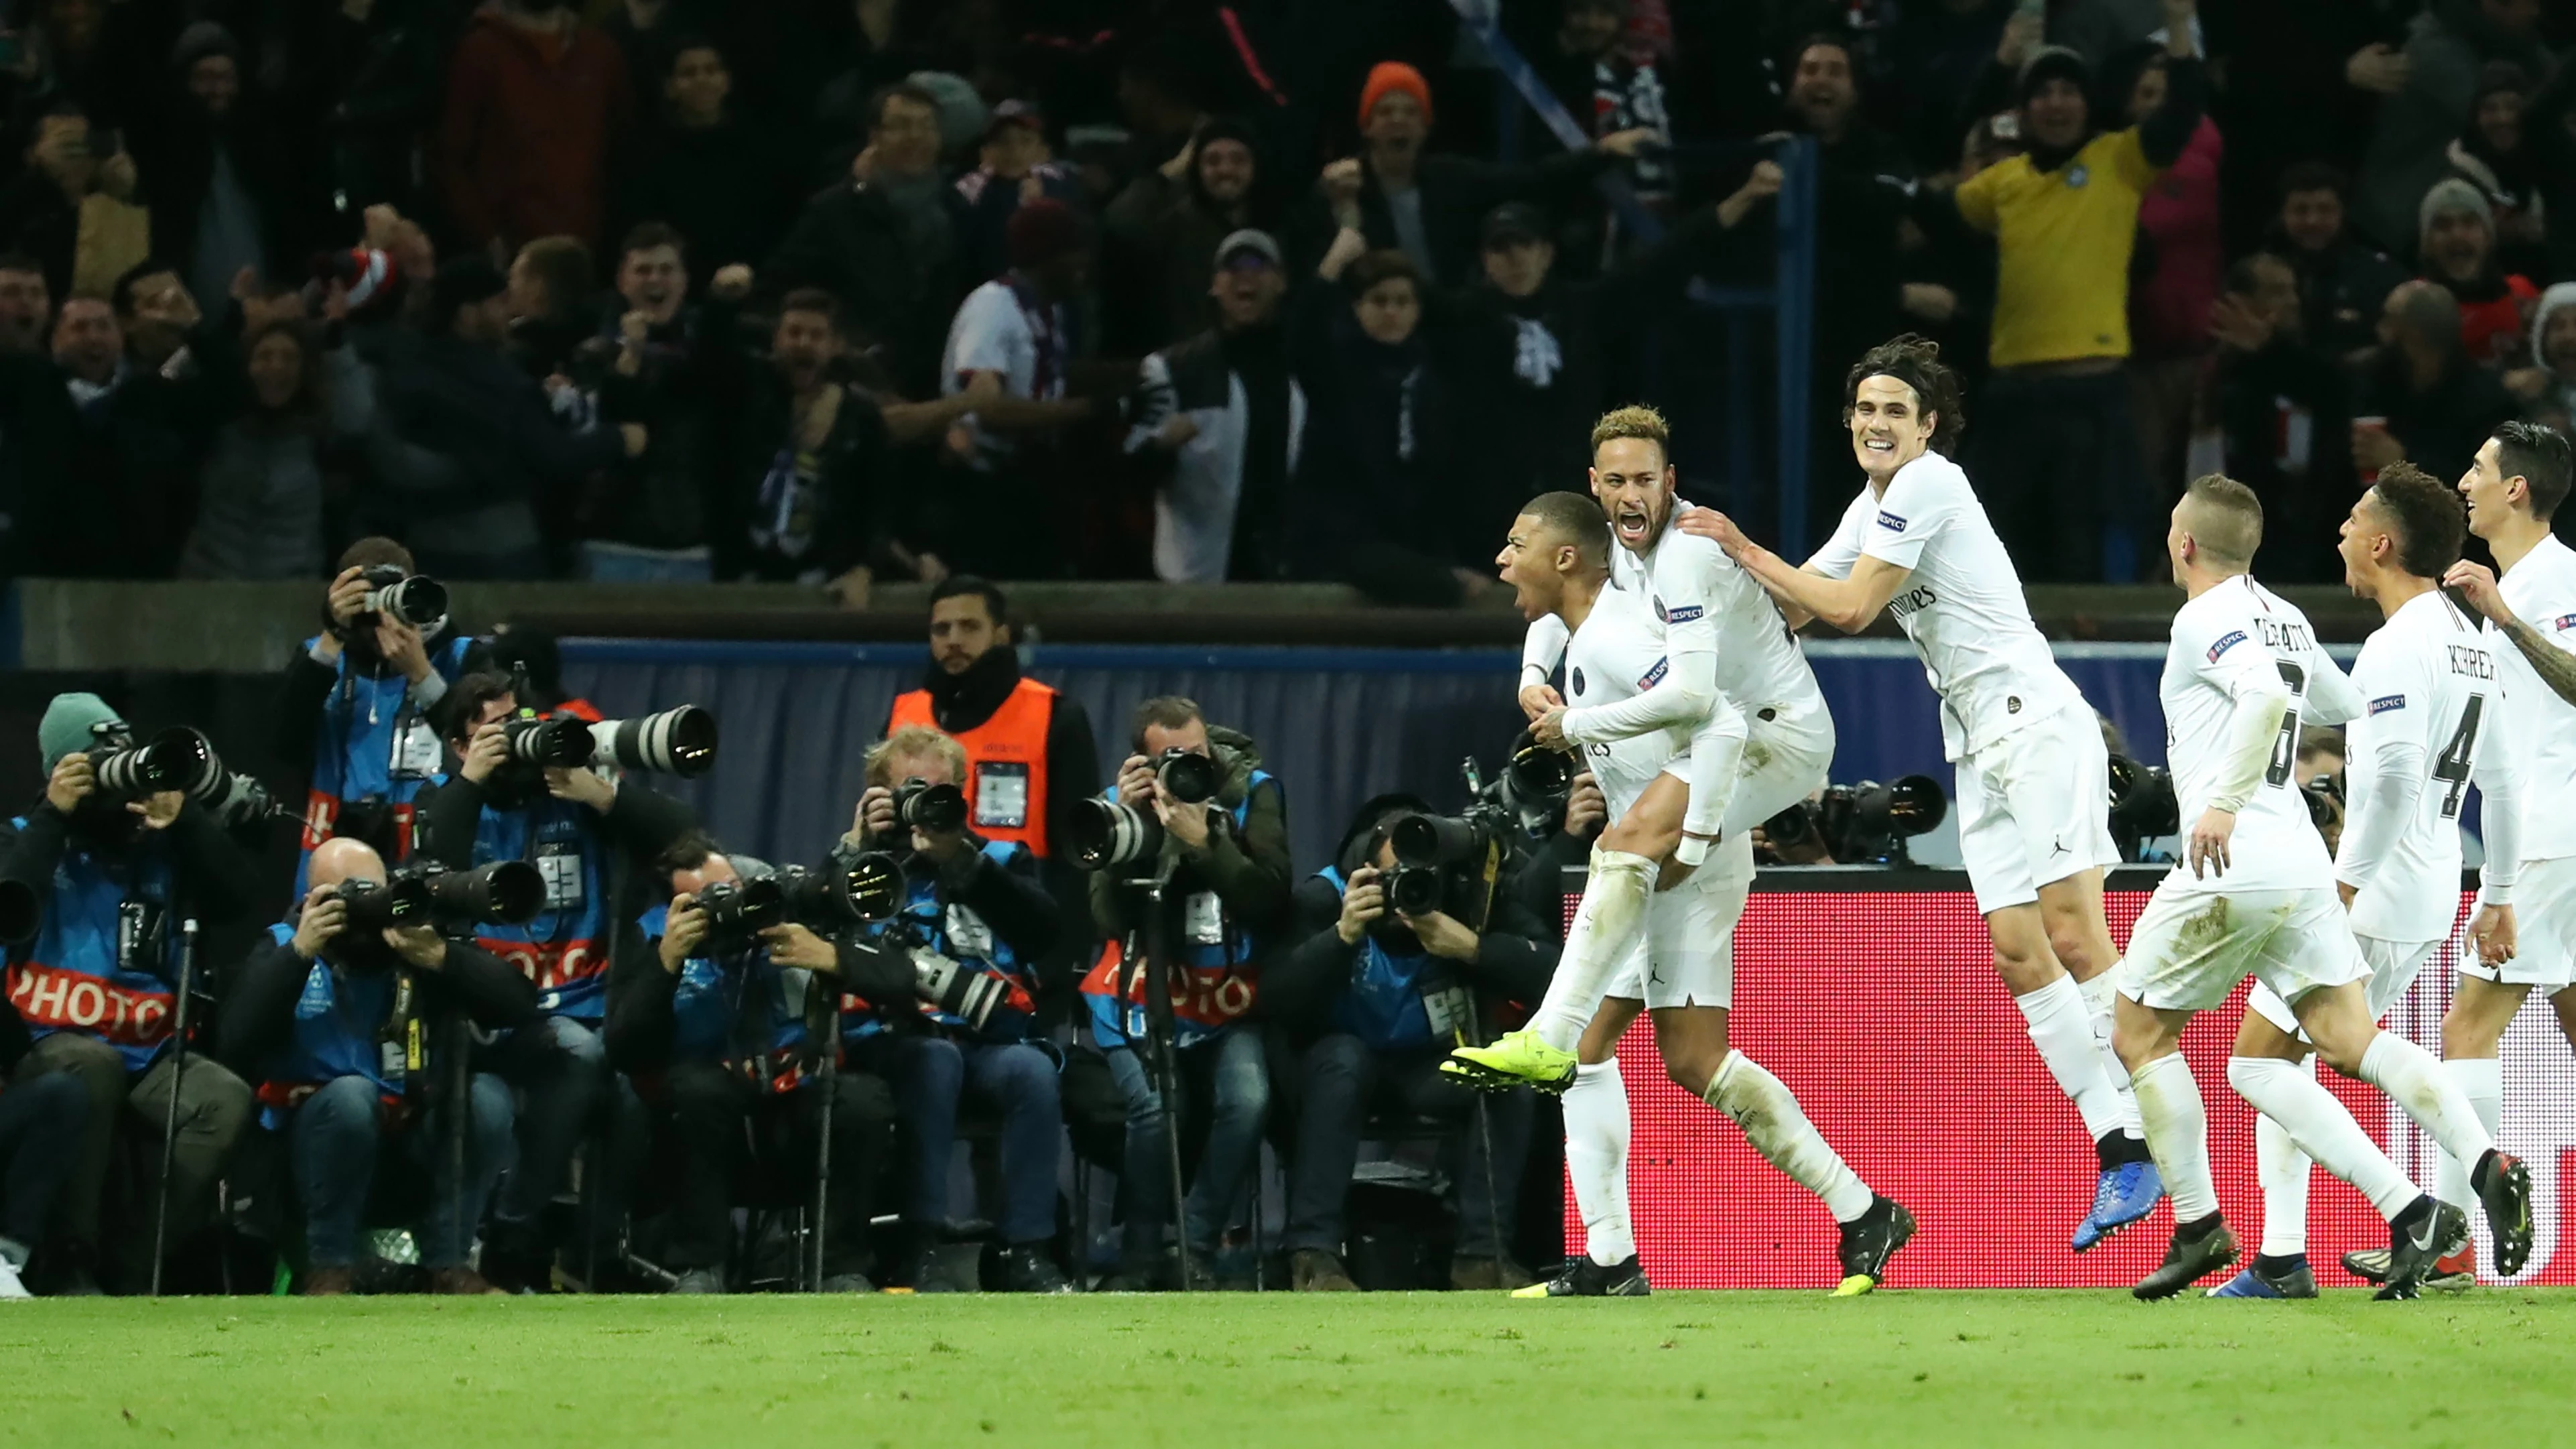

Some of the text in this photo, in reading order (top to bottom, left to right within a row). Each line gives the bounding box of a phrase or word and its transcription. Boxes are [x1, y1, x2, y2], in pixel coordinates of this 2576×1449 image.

[1671, 609, 1702, 620] RESPECT
[2213, 632, 2246, 653] RESPECT
[2373, 698, 2404, 710] RESPECT
[2431, 692, 2484, 819] 4
[10, 968, 168, 1040] PHOTO
